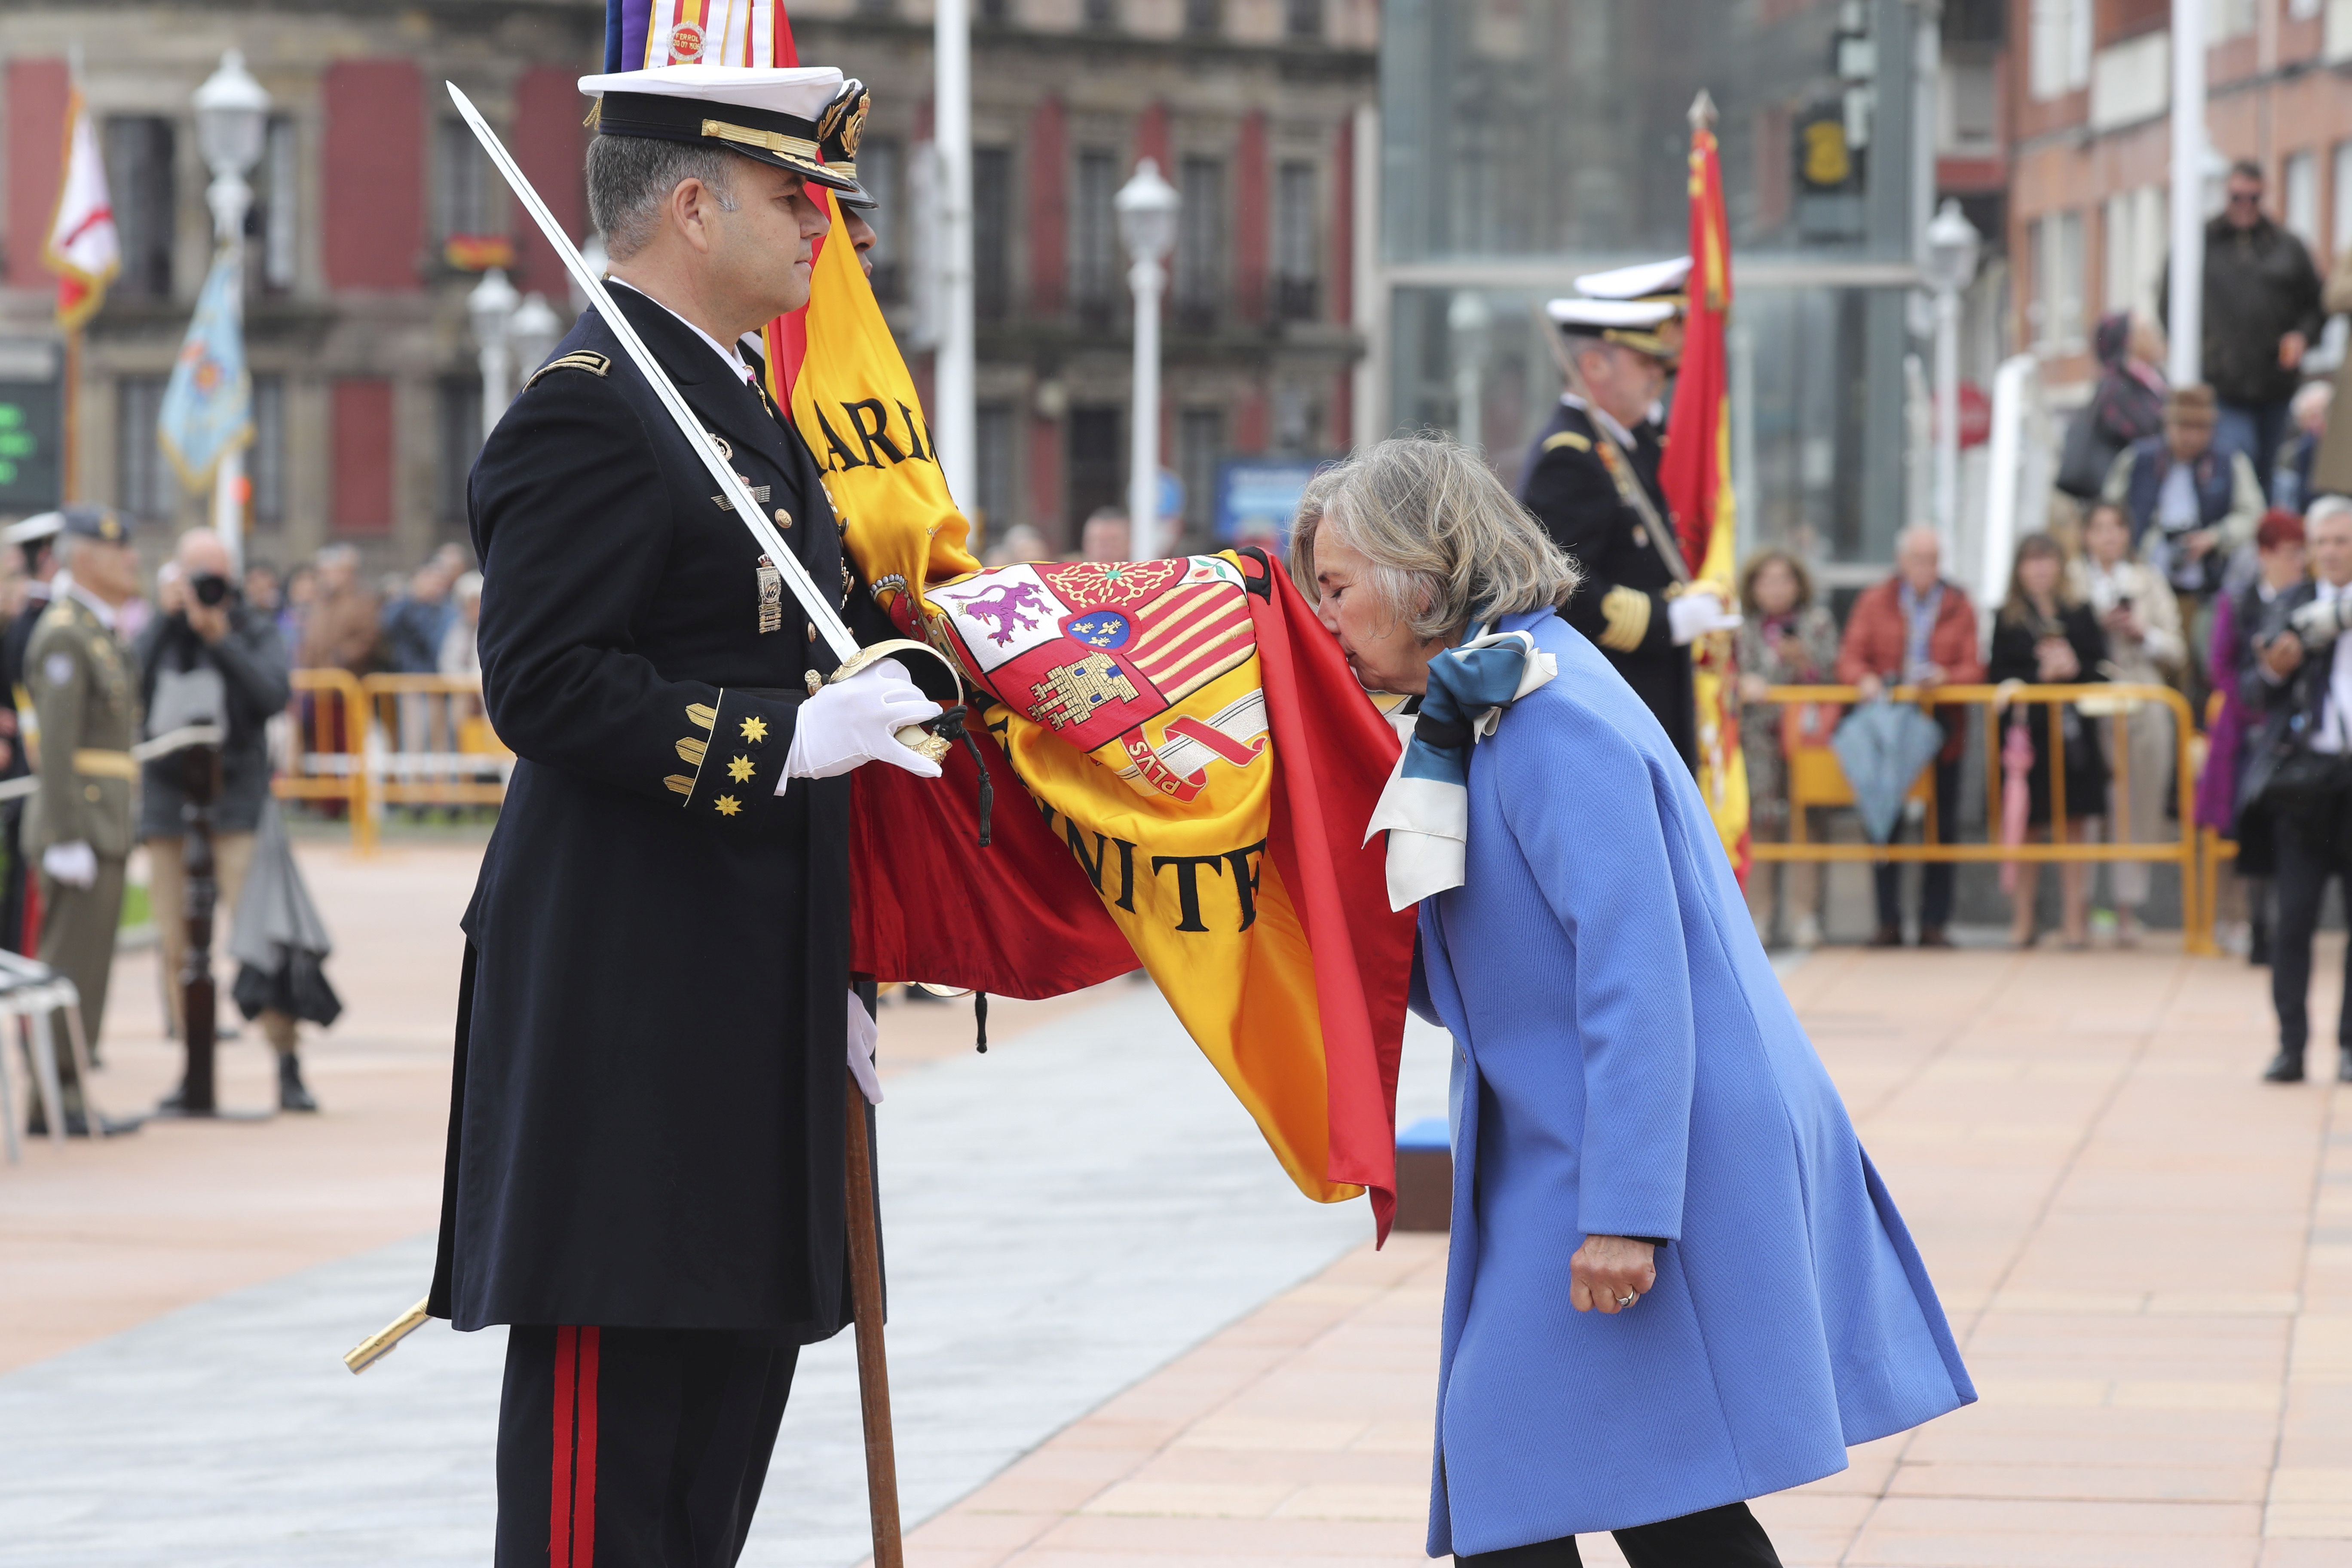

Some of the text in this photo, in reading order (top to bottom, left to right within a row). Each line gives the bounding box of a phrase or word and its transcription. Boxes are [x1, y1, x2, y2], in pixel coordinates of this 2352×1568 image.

[675, 33, 699, 42] FERROL
[795, 397, 934, 477] ARI
[1129, 741, 1182, 795] PLVS
